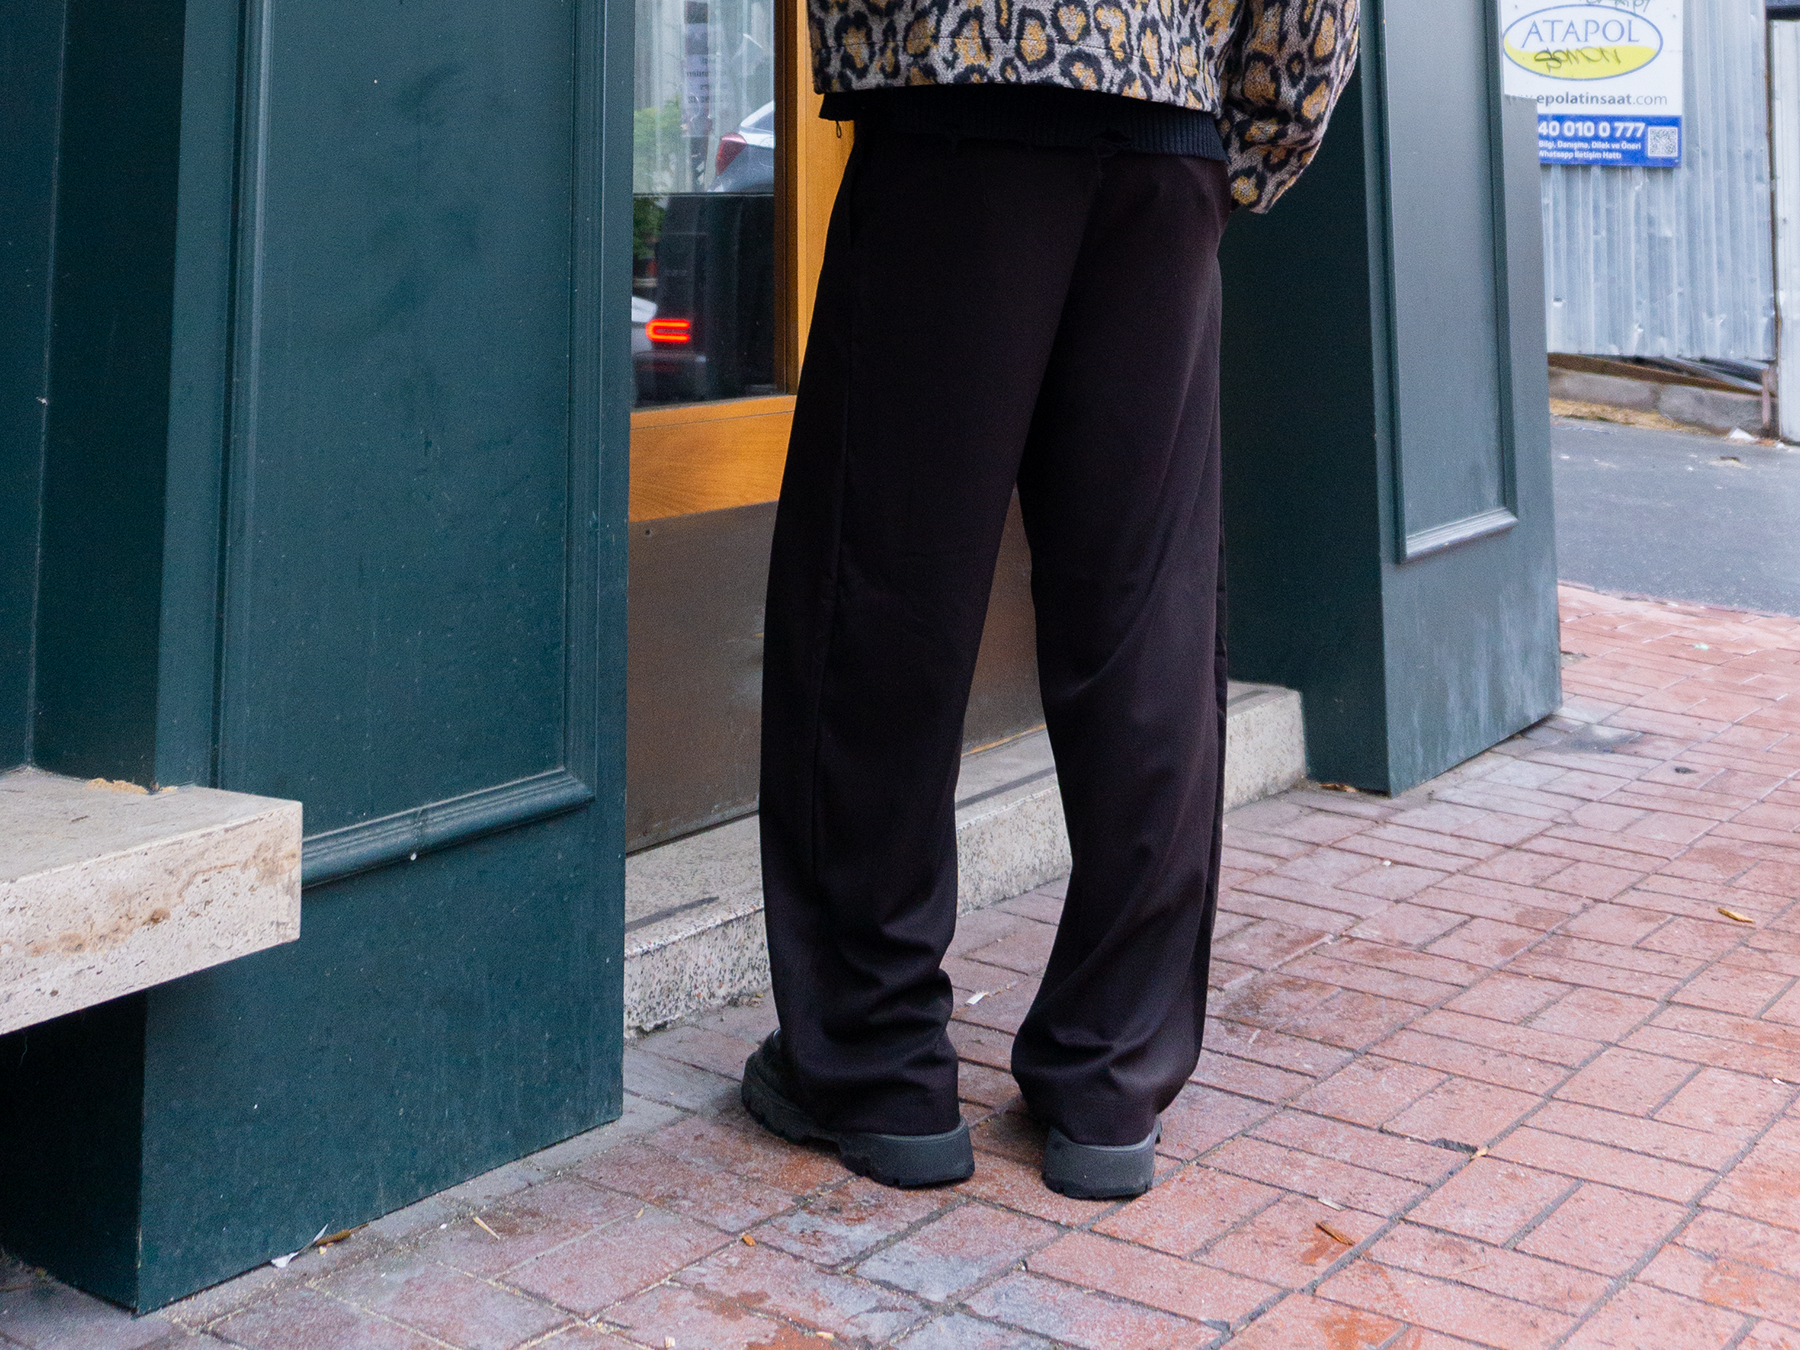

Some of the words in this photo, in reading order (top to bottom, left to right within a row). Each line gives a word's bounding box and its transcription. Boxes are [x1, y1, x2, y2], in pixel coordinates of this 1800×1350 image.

[1521, 19, 1640, 48] ATAPOL
[1563, 121, 1595, 137] 010
[1598, 122, 1611, 137] 0
[1614, 122, 1646, 138] 777
